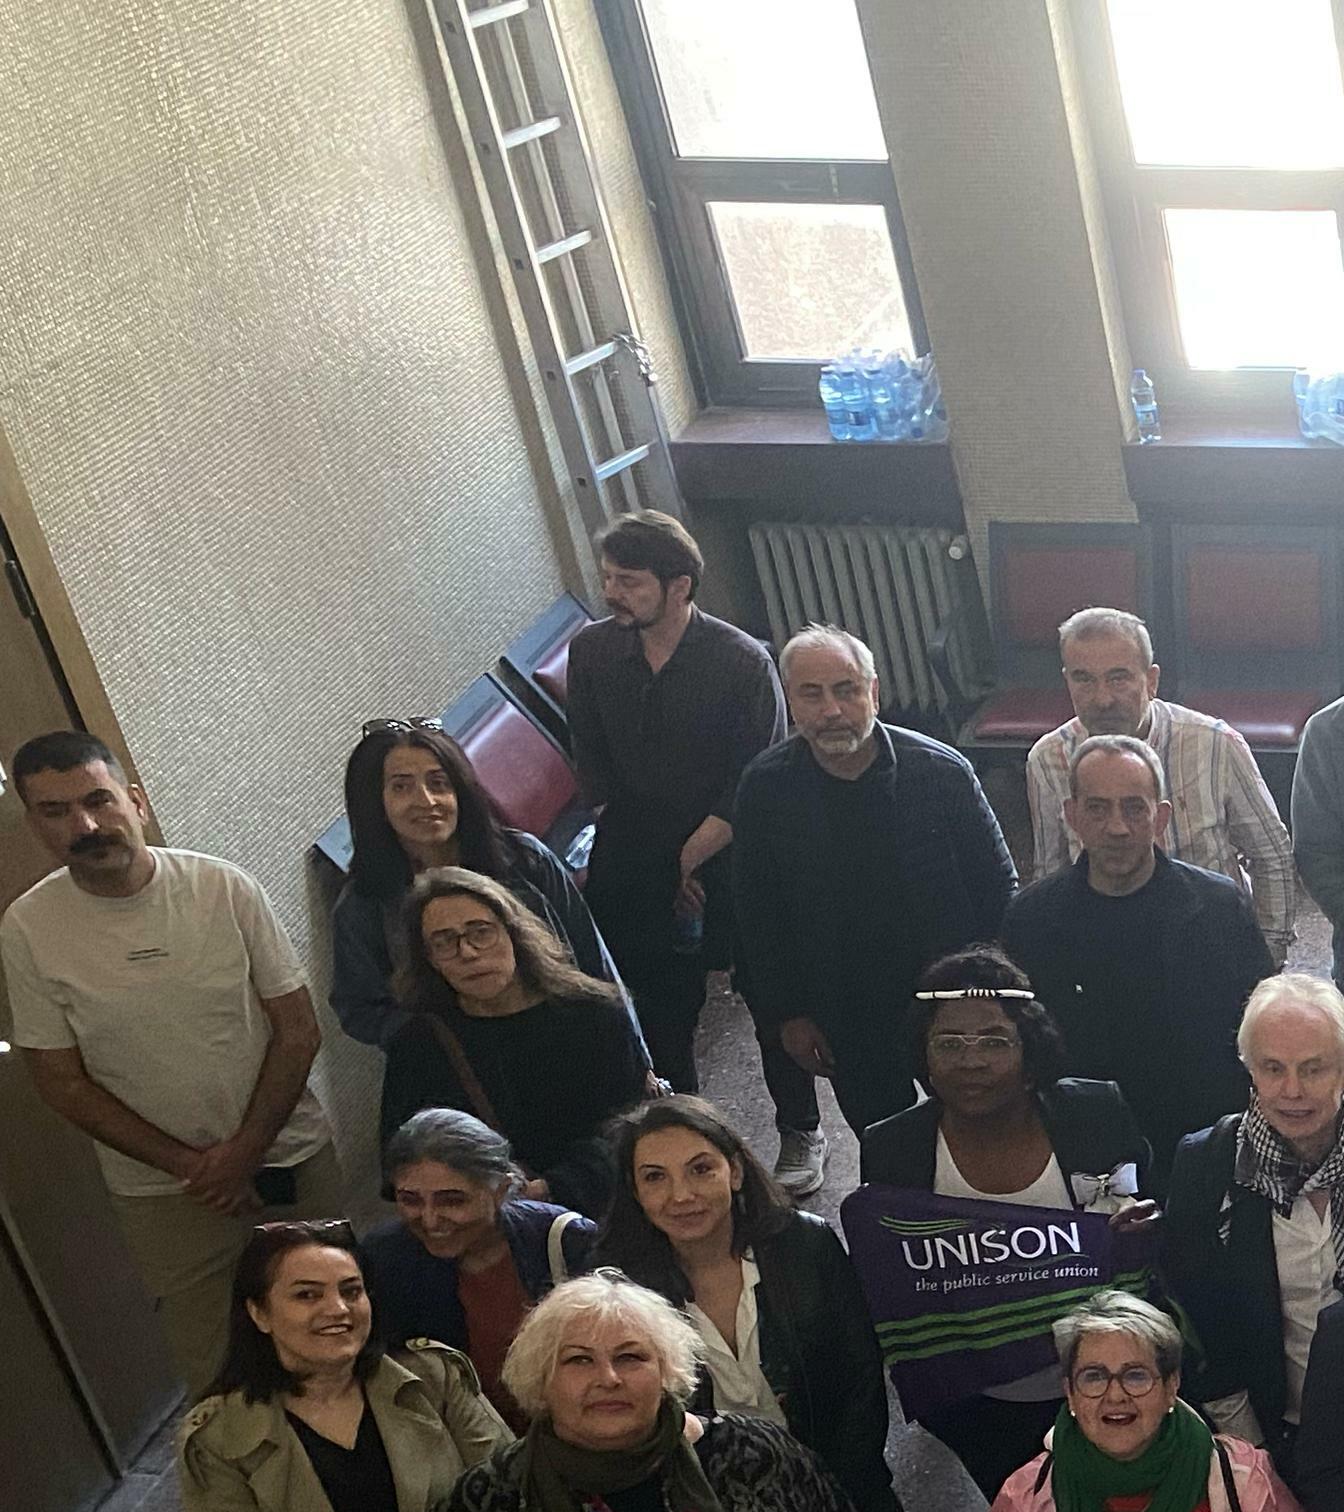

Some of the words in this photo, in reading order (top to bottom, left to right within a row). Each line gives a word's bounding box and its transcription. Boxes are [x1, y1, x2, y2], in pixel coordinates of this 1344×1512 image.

[901, 1221, 1081, 1271] UNISON
[915, 1276, 938, 1292] the
[943, 1271, 990, 1295] public
[995, 1266, 1049, 1285] service
[1054, 1264, 1099, 1279] union
